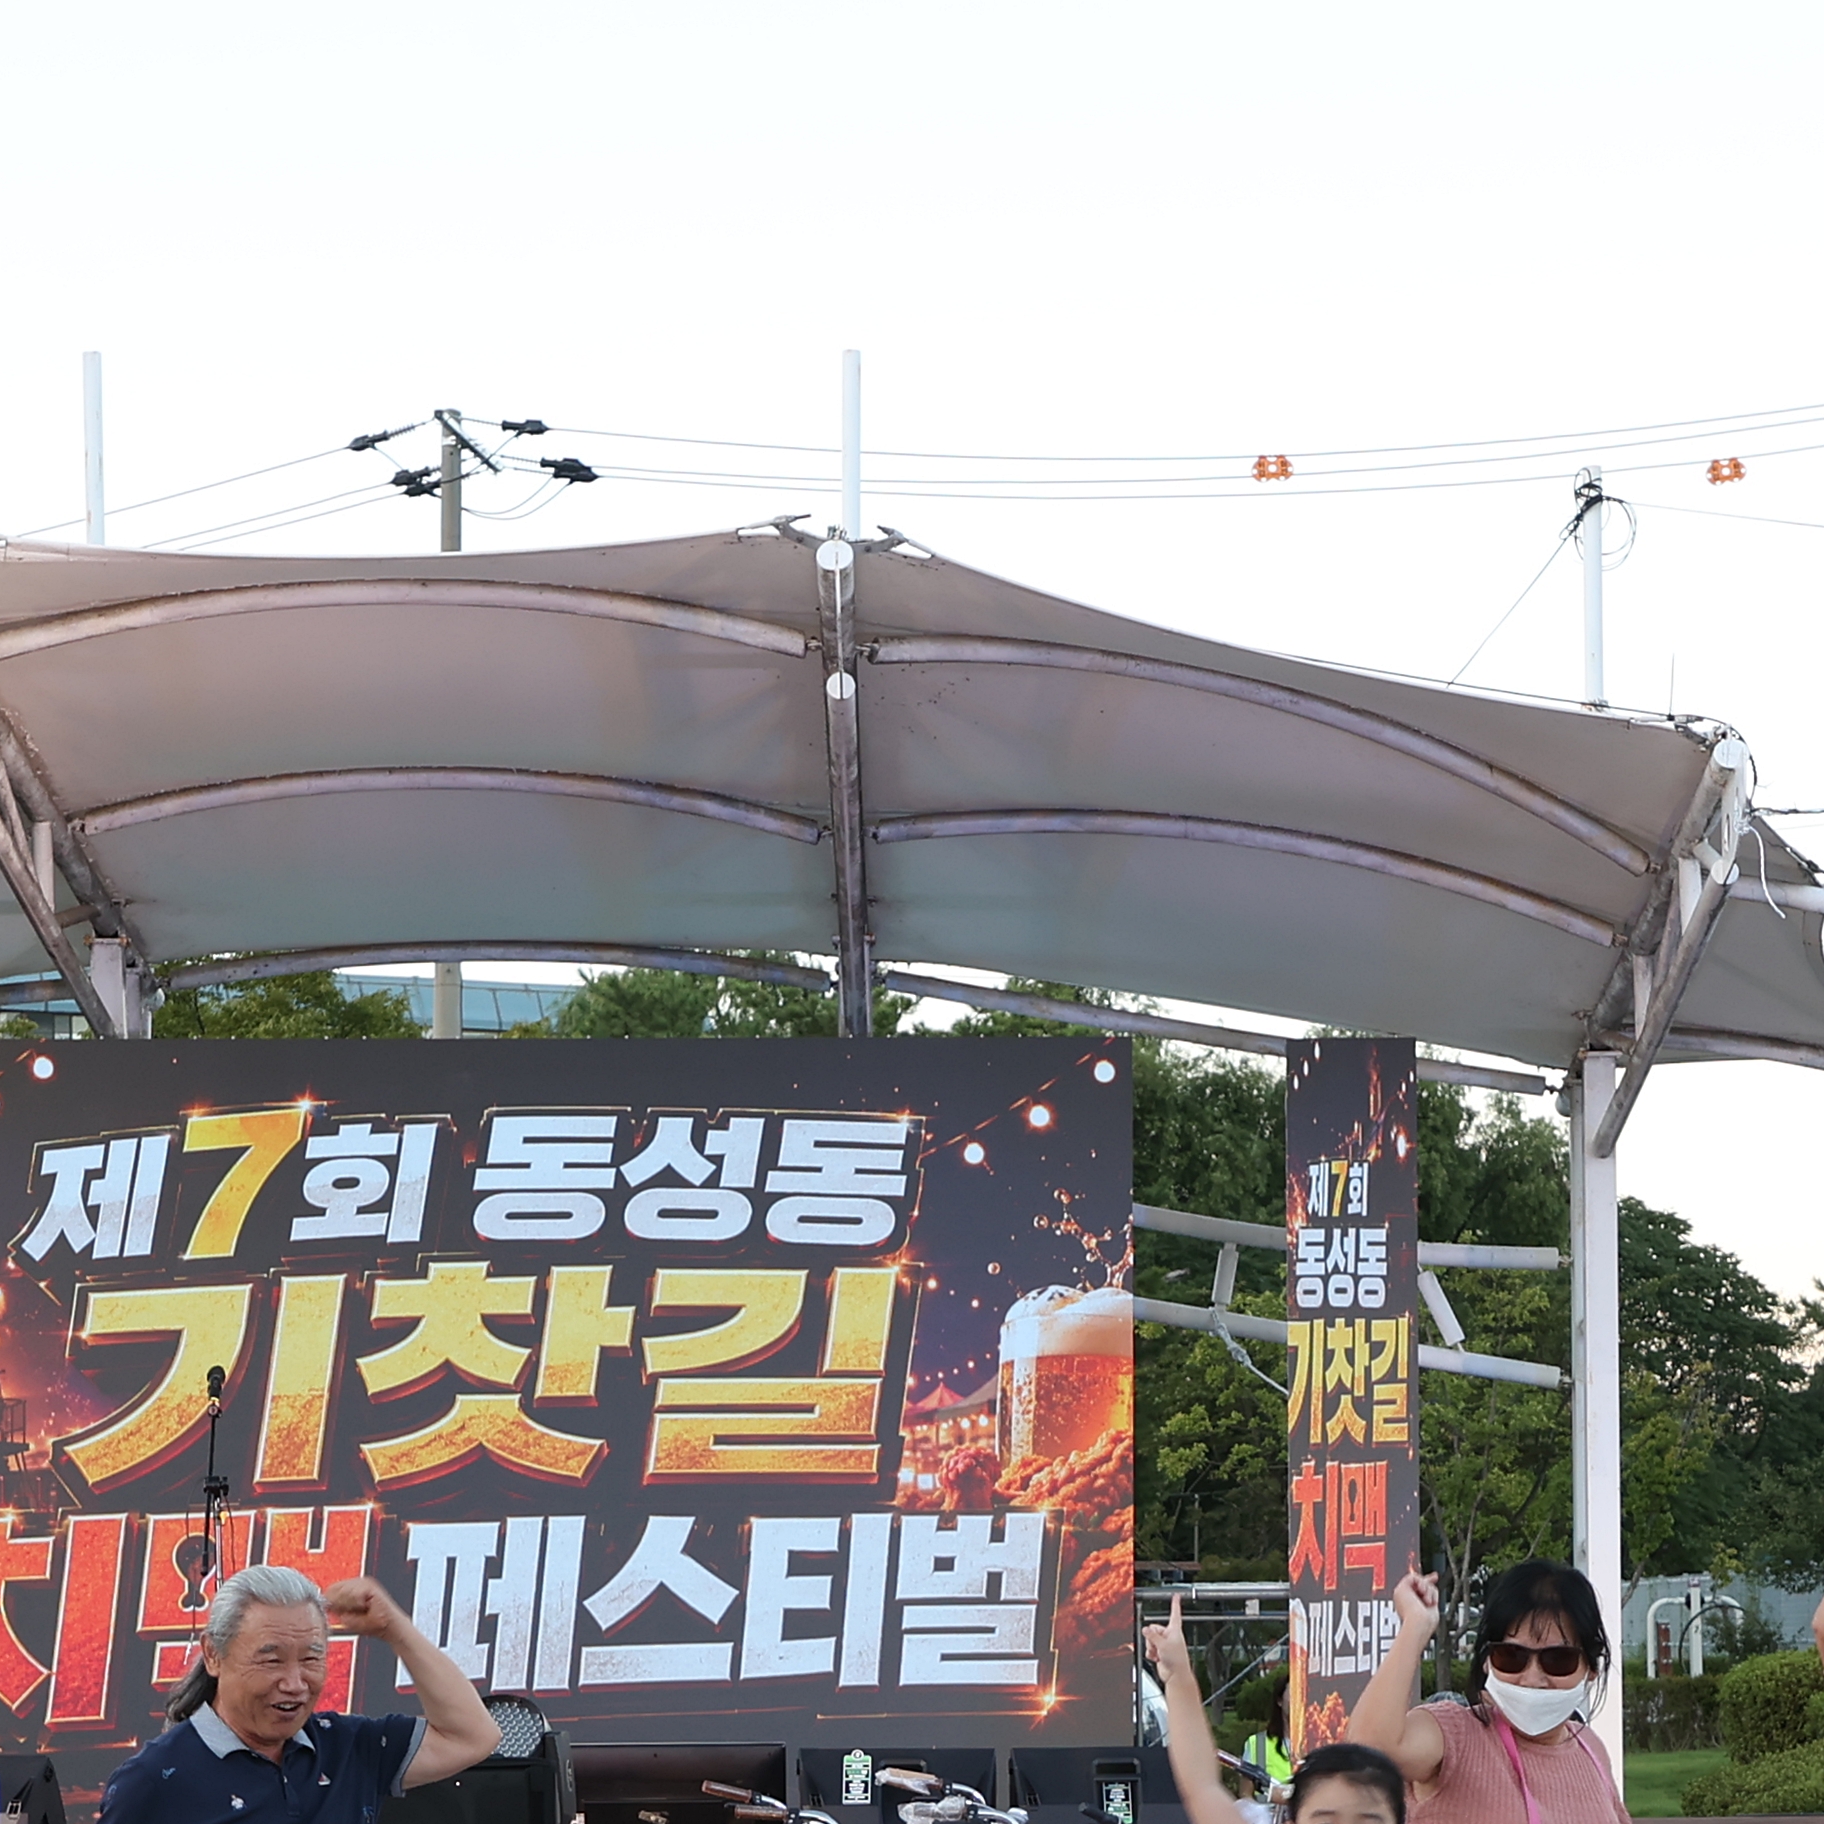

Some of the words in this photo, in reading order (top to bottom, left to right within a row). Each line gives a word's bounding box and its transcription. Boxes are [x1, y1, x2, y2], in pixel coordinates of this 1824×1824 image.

[22, 1104, 436, 1260] 제7회
[472, 1113, 909, 1243] 동성동
[1307, 1160, 1368, 1218] 제7회
[1296, 1228, 1388, 1309] 동성동
[63, 1266, 897, 1490] 기찻길
[1288, 1317, 1410, 1444] 기찻길
[1290, 1459, 1387, 1591] 치맥
[396, 1514, 1050, 1691] 페스티벌
